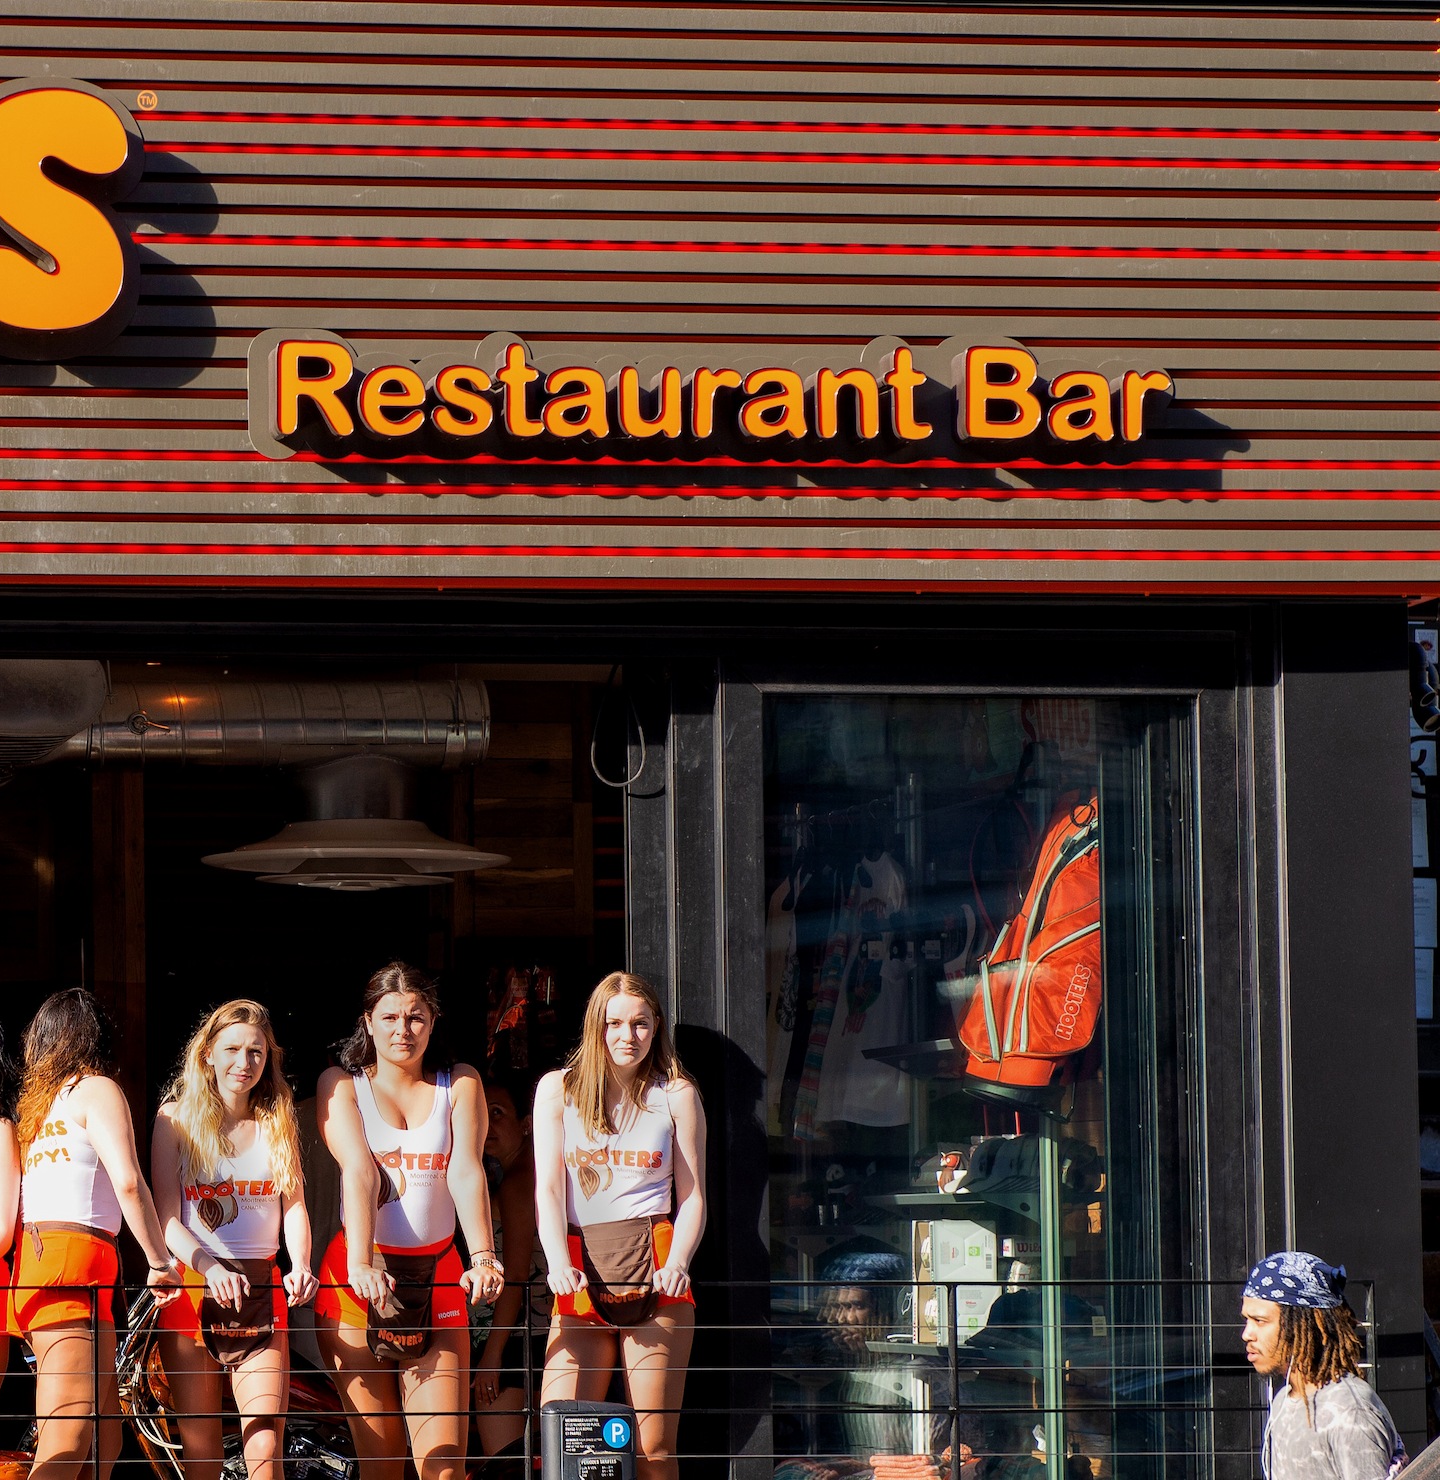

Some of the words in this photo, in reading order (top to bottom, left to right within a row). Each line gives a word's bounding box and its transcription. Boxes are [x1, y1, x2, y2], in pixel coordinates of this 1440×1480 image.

[275, 339, 933, 443] Restaurant
[960, 345, 1172, 444] Bar
[1055, 963, 1092, 1040] HOOTERS
[565, 1150, 664, 1169] HOOTERS
[377, 1329, 424, 1347] HOOTERS
[611, 1422, 625, 1444] P
